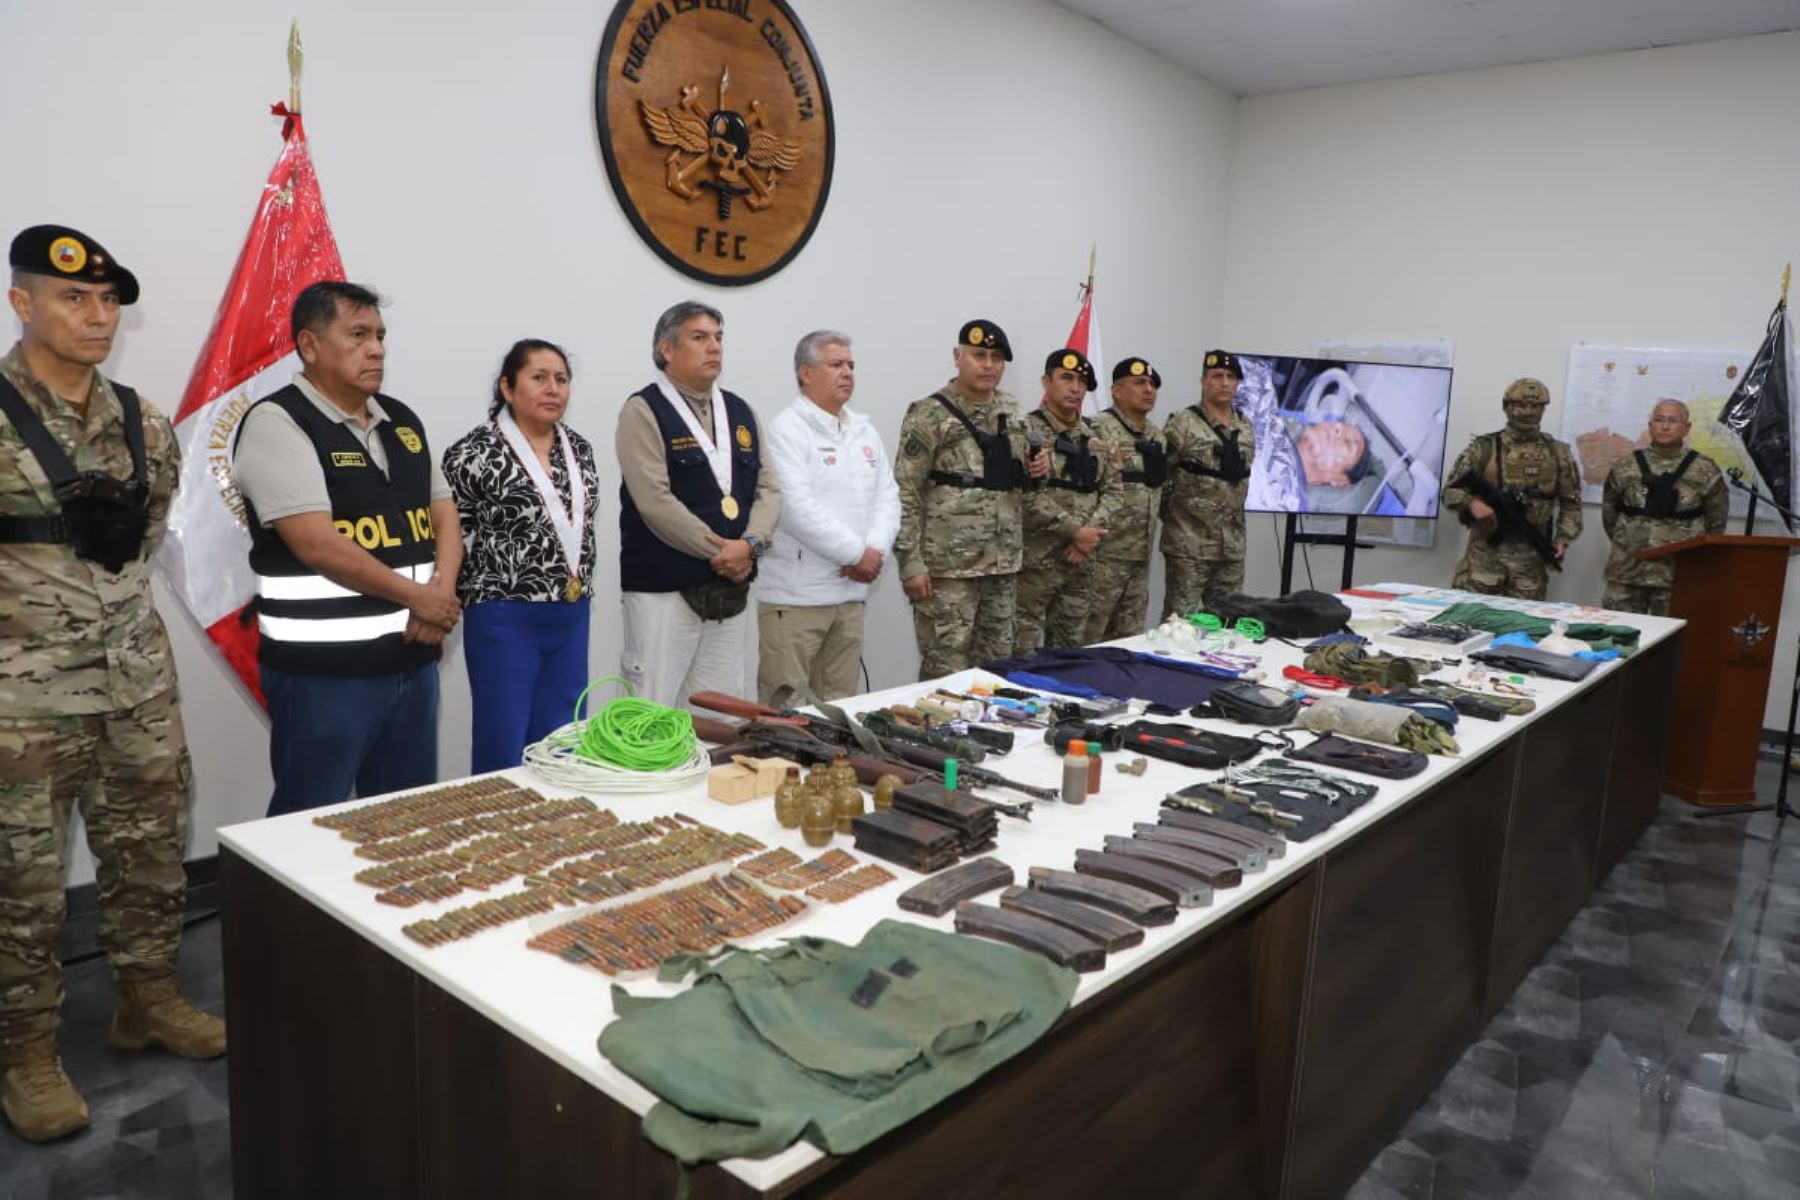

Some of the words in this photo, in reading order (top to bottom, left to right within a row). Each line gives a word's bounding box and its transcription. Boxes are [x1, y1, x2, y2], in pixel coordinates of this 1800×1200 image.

[623, 2, 671, 83] FUERZA
[760, 16, 814, 120] CONJUNTA
[696, 227, 748, 261] FEC
